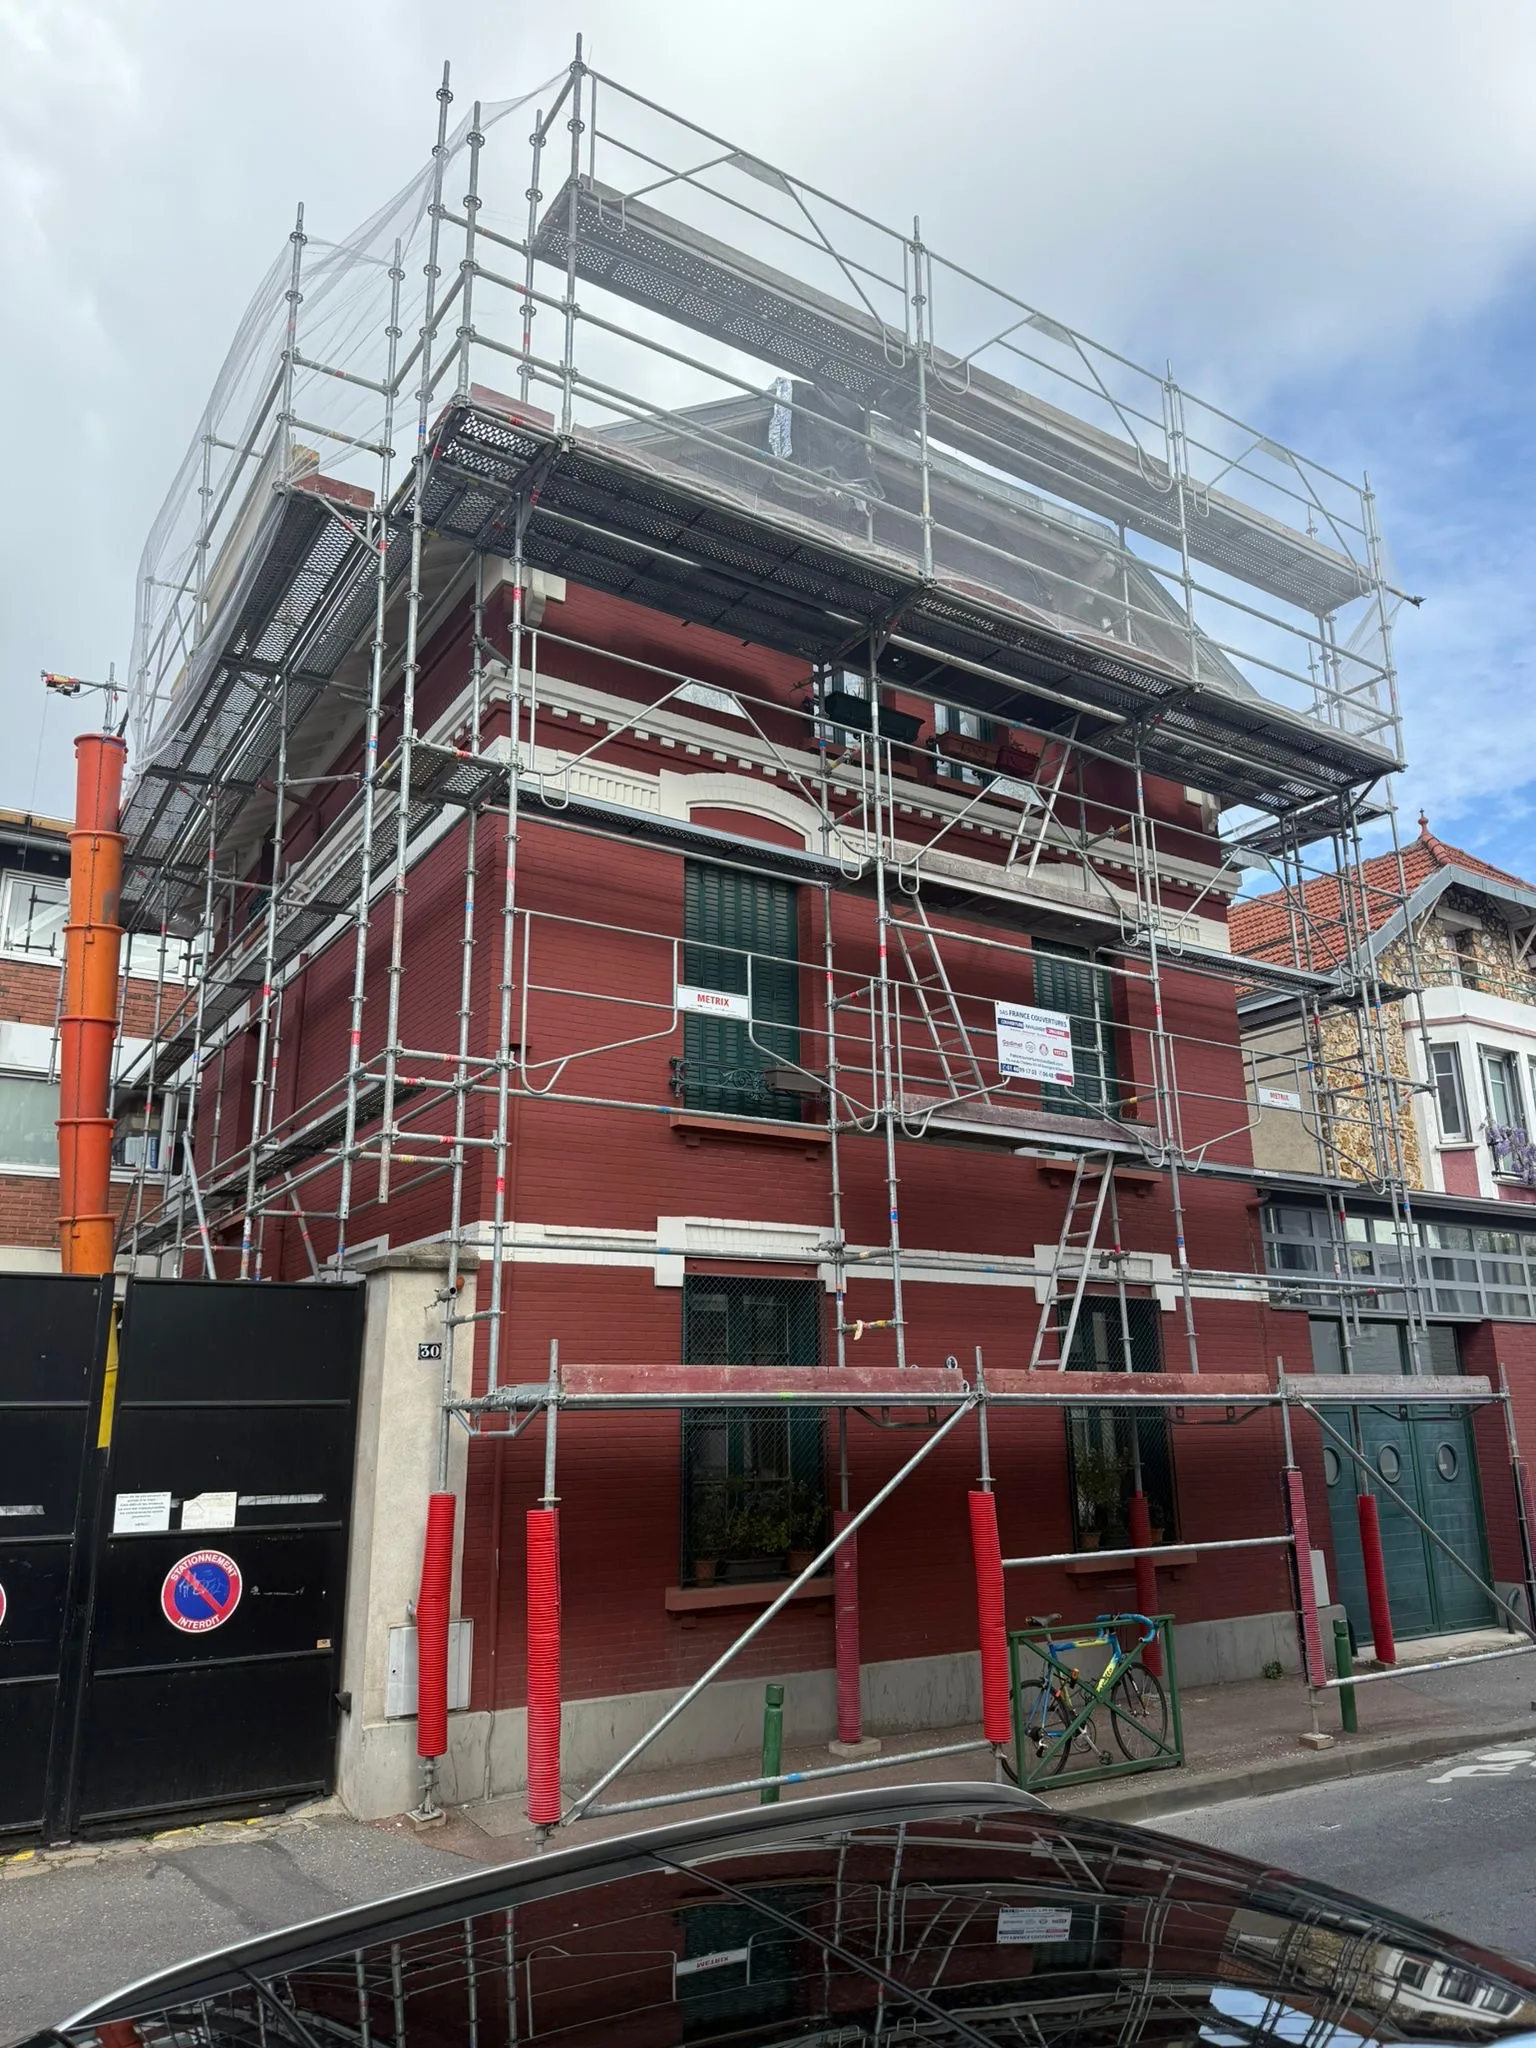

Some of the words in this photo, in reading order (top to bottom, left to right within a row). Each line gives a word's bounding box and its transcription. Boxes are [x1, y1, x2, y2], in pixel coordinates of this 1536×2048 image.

[697, 994, 729, 1007] METRIX
[1009, 1010, 1030, 1020] FRANCE
[1031, 1014, 1067, 1028] COUVERTURES
[420, 1345, 440, 1358] 30
[170, 1553, 237, 1581] STATIONNEMENT
[177, 1614, 220, 1630] INTERDIT
